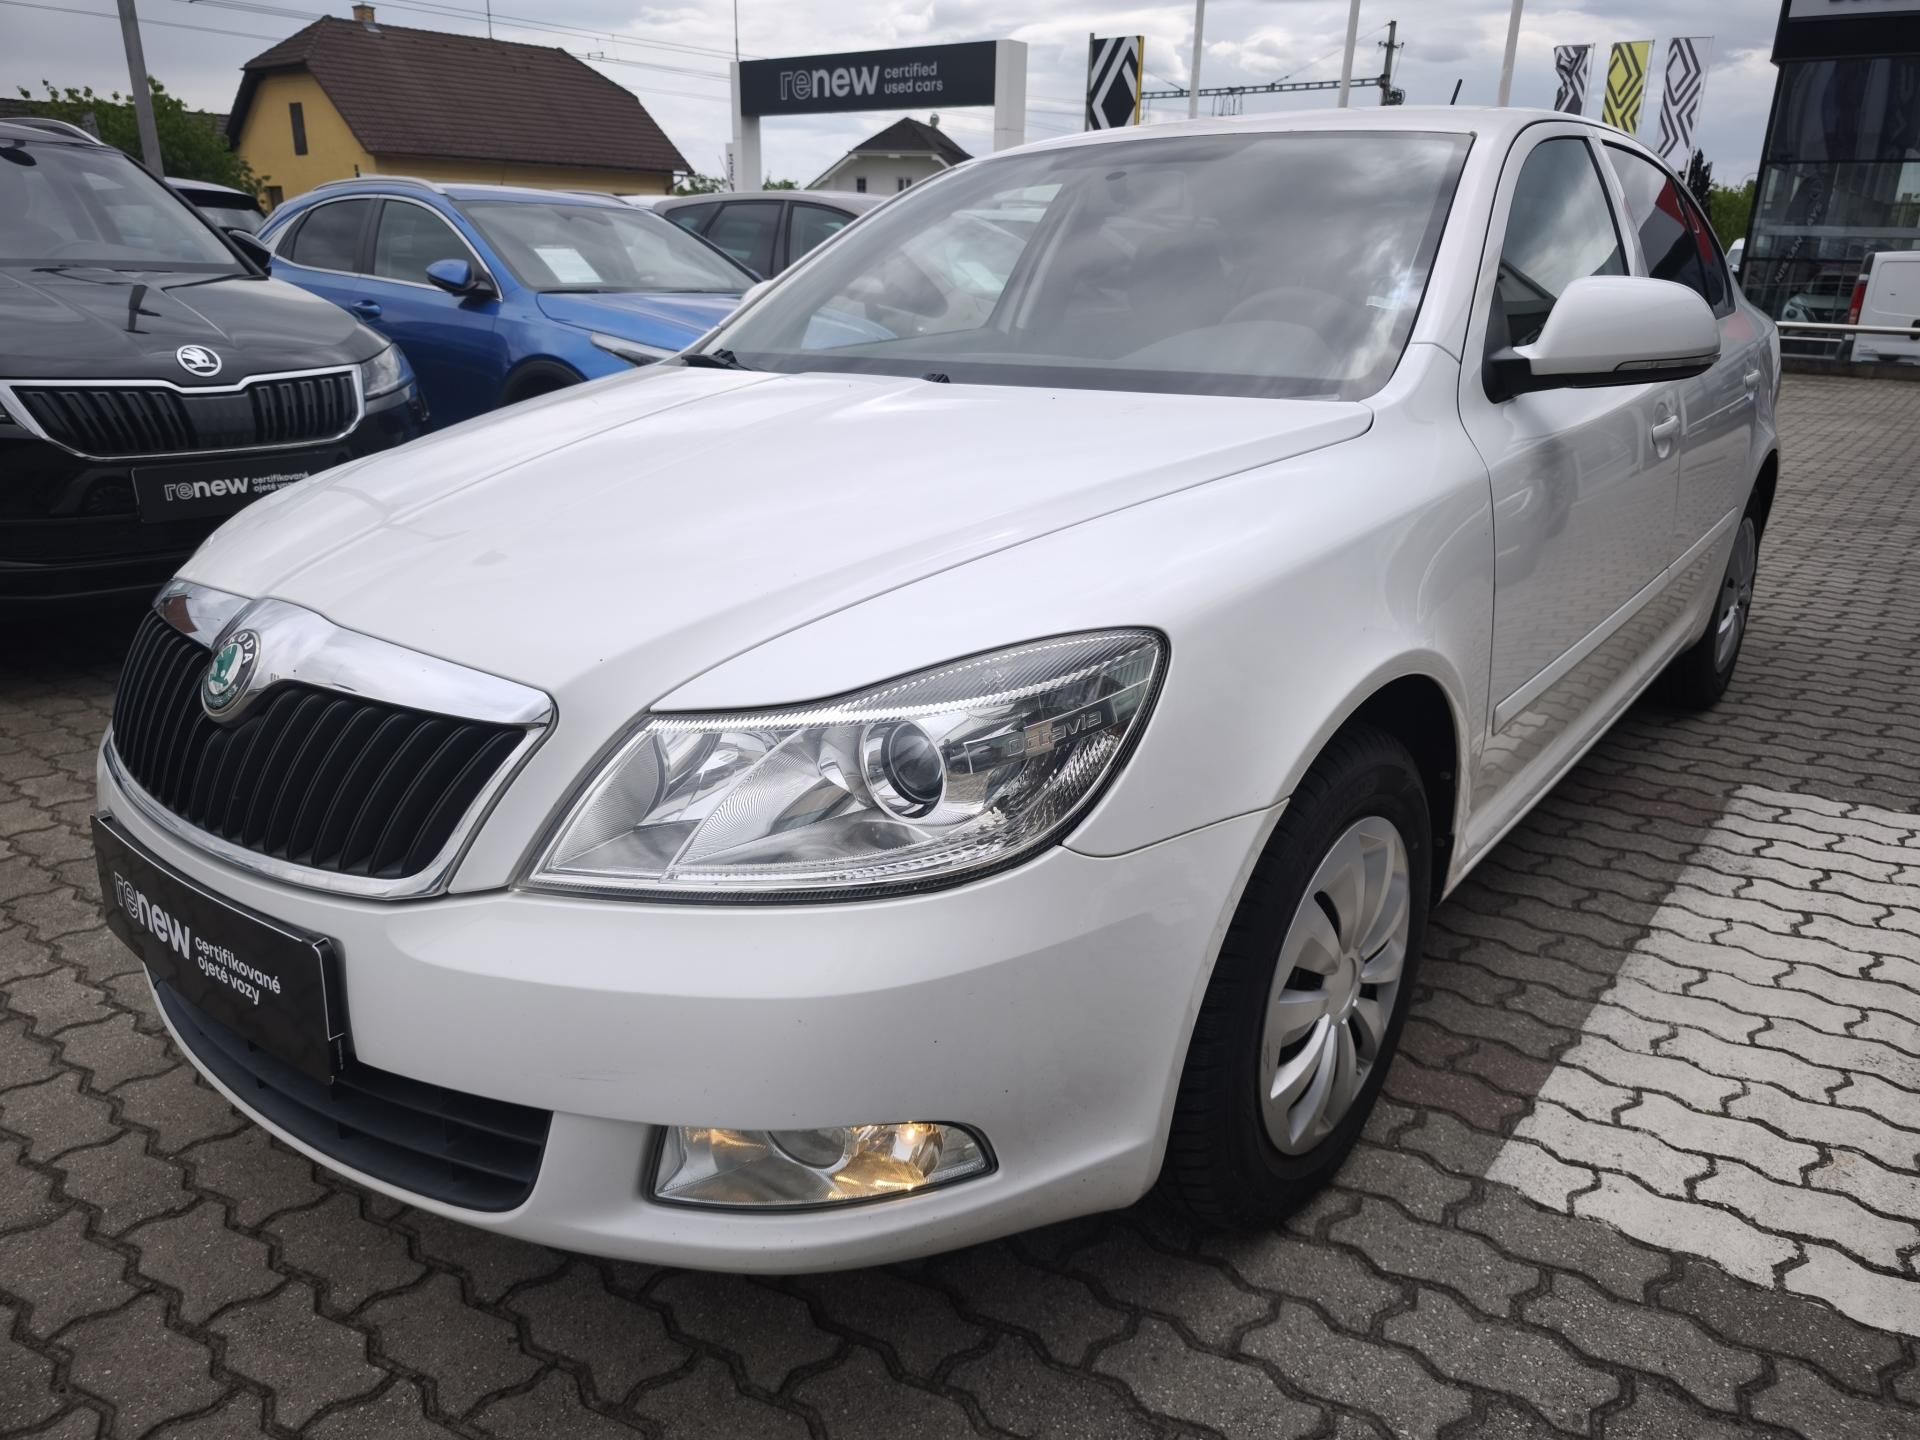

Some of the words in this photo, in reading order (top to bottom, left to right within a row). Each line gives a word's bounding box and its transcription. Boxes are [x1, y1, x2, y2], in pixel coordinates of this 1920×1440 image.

[780, 65, 880, 100] renew
[884, 62, 938, 79] certified
[884, 79, 914, 94] used
[915, 79, 943, 92] cars
[164, 477, 249, 501] renew
[114, 872, 190, 960] renew
[195, 936, 281, 994] certifikované
[198, 955, 228, 983] ojeté
[229, 974, 260, 1005] vozy
